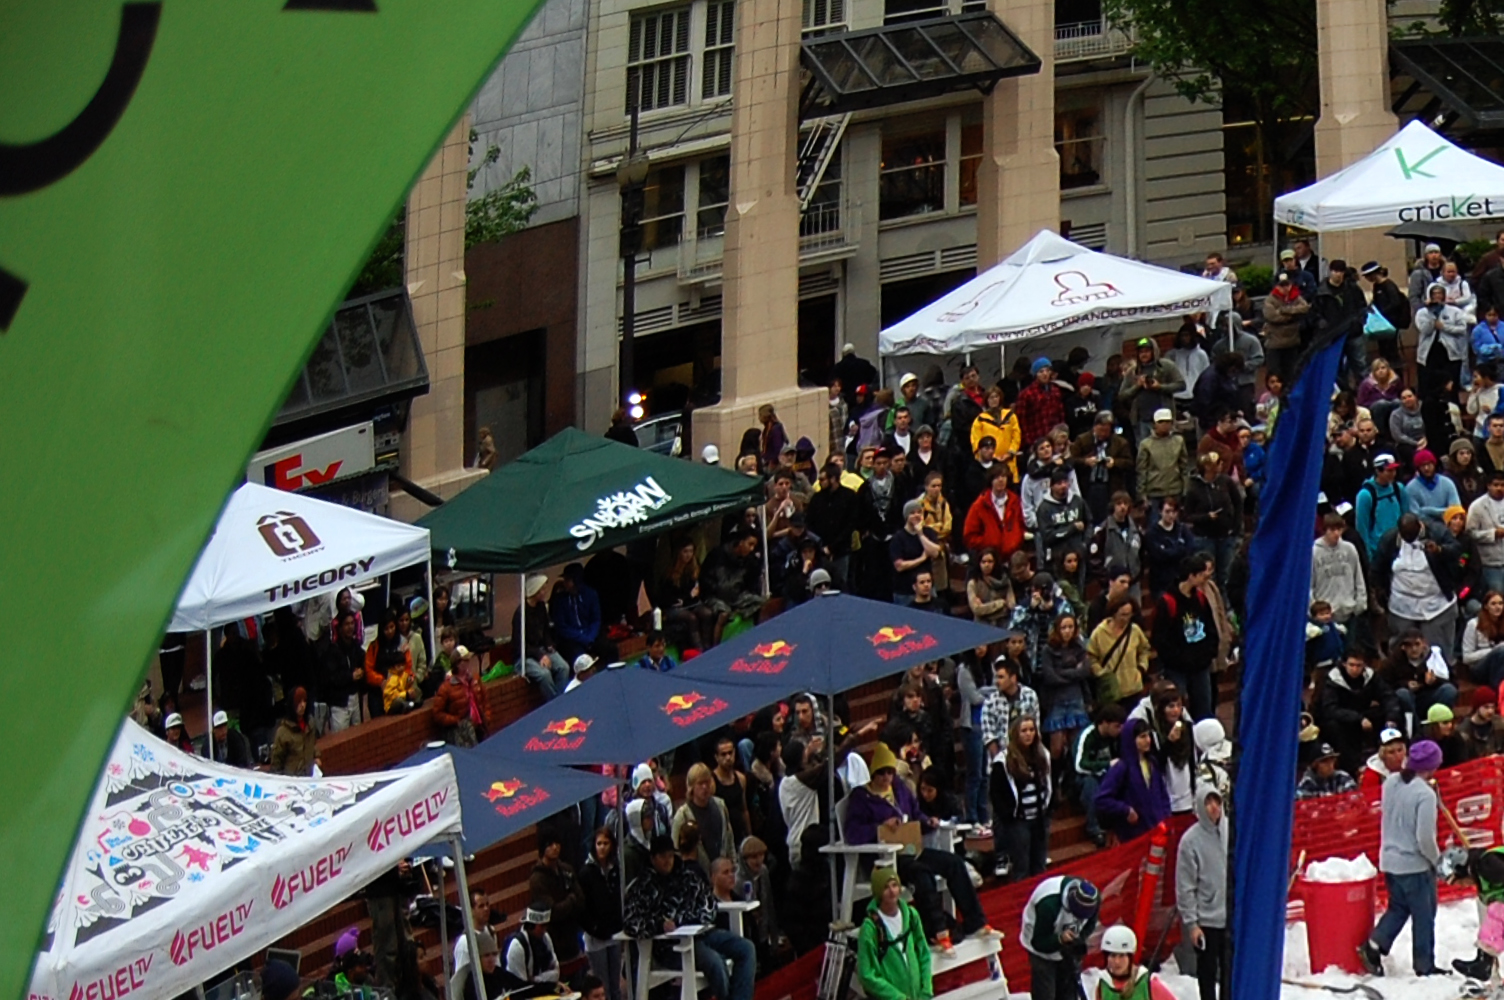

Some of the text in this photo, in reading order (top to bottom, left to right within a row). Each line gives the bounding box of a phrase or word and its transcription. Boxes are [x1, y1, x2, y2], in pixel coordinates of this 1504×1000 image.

[264, 556, 376, 602] THEORY
[524, 736, 586, 751] Red Bull
[383, 787, 449, 847] FUEL TV
[287, 842, 354, 903] FUEL TV
[187, 899, 254, 963] FUEL TV
[135, 953, 155, 976] TV
